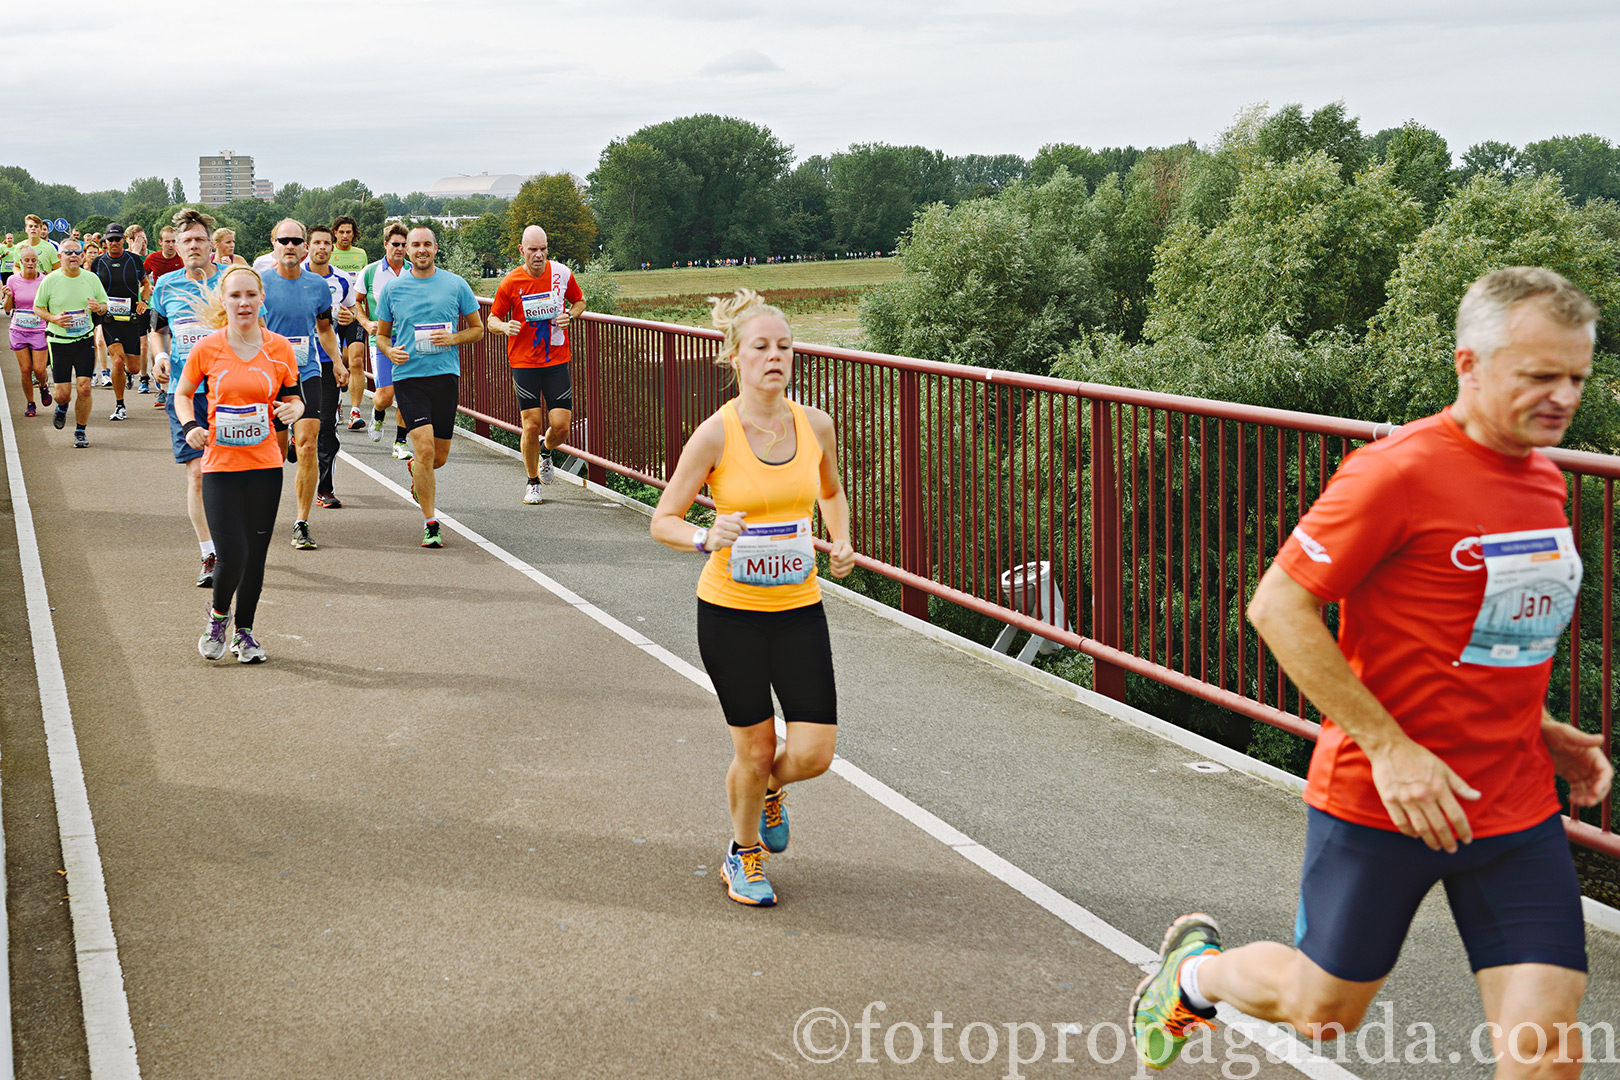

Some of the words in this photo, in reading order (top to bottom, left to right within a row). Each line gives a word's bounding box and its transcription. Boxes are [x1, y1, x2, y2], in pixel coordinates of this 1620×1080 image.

[110, 306, 126, 314] Rudy
[525, 305, 558, 317] Reinier
[224, 425, 261, 438] Linda
[747, 555, 802, 578] Mijke
[1511, 592, 1552, 621] Jan
